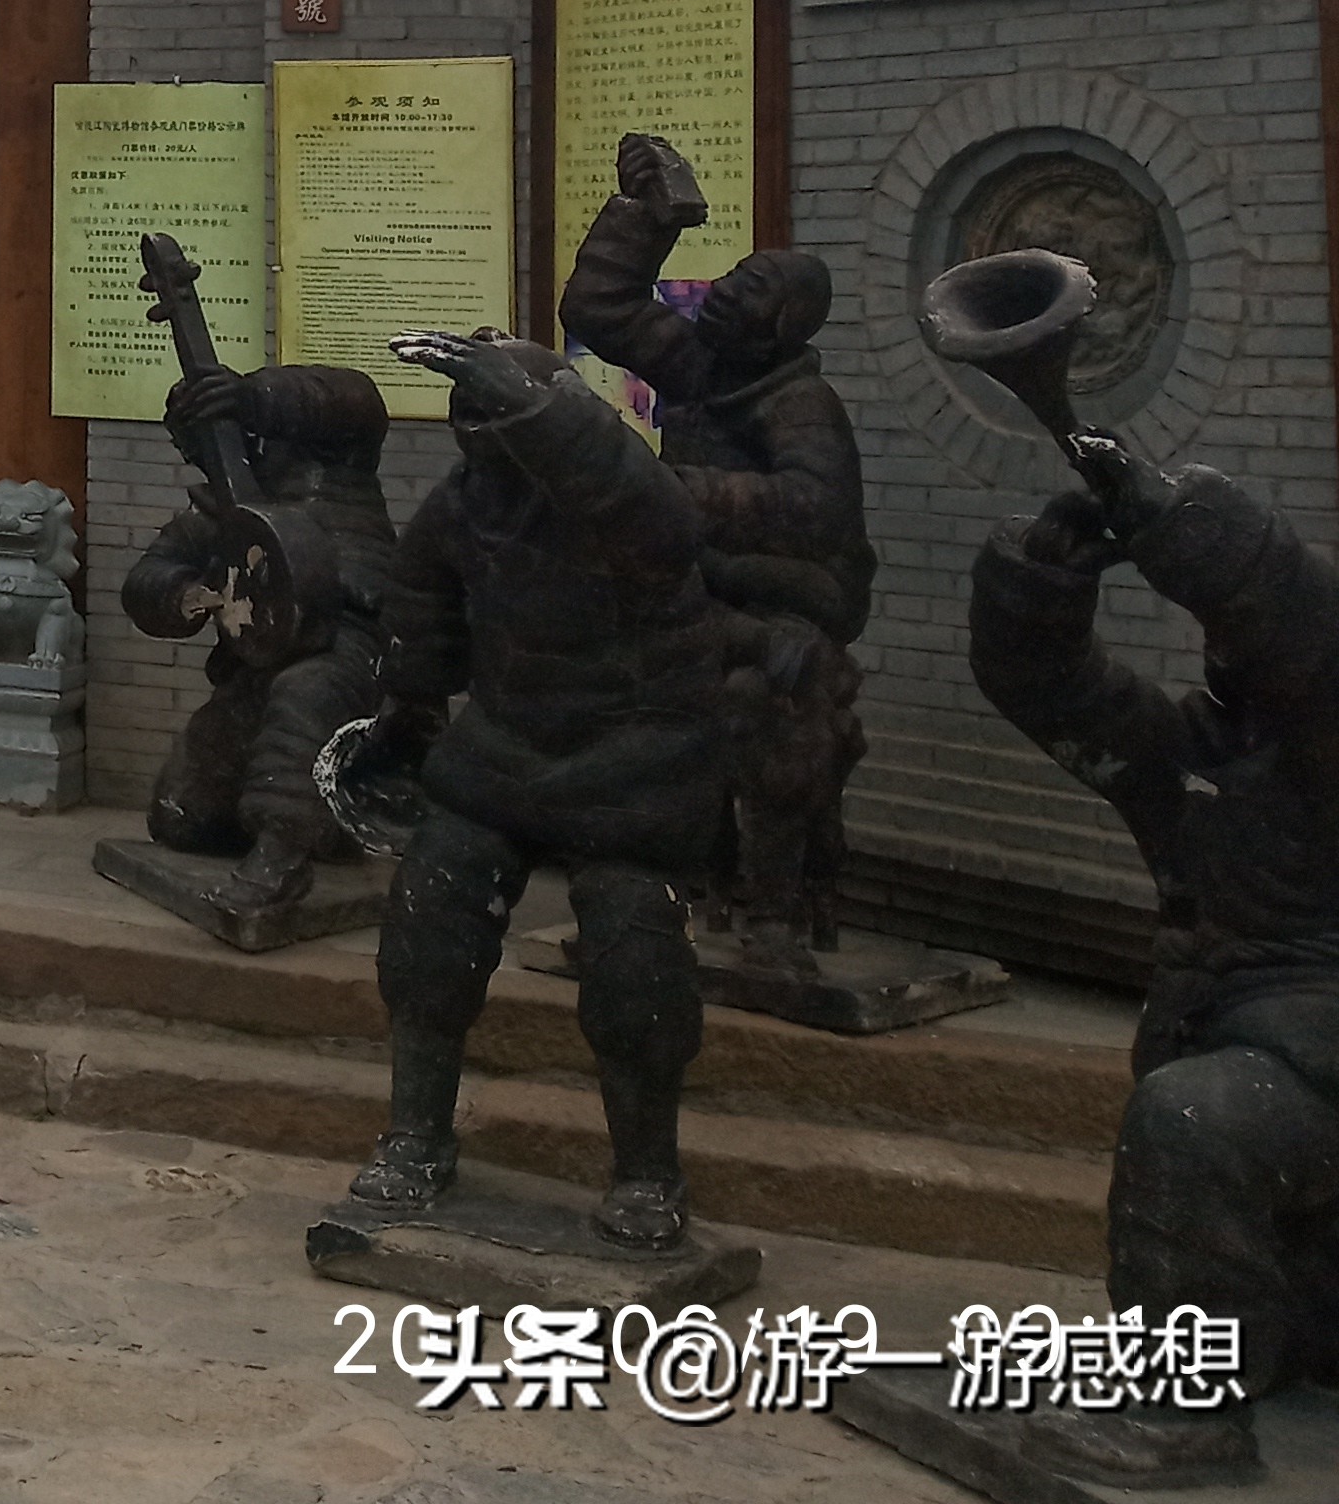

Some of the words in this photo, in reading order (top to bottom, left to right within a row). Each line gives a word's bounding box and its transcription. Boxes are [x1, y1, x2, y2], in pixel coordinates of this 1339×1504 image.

[345, 96, 441, 108] 参观须知
[332, 113, 390, 122] 本馆开放时间
[354, 234, 395, 245] Visiting
[397, 234, 433, 244] Notice
